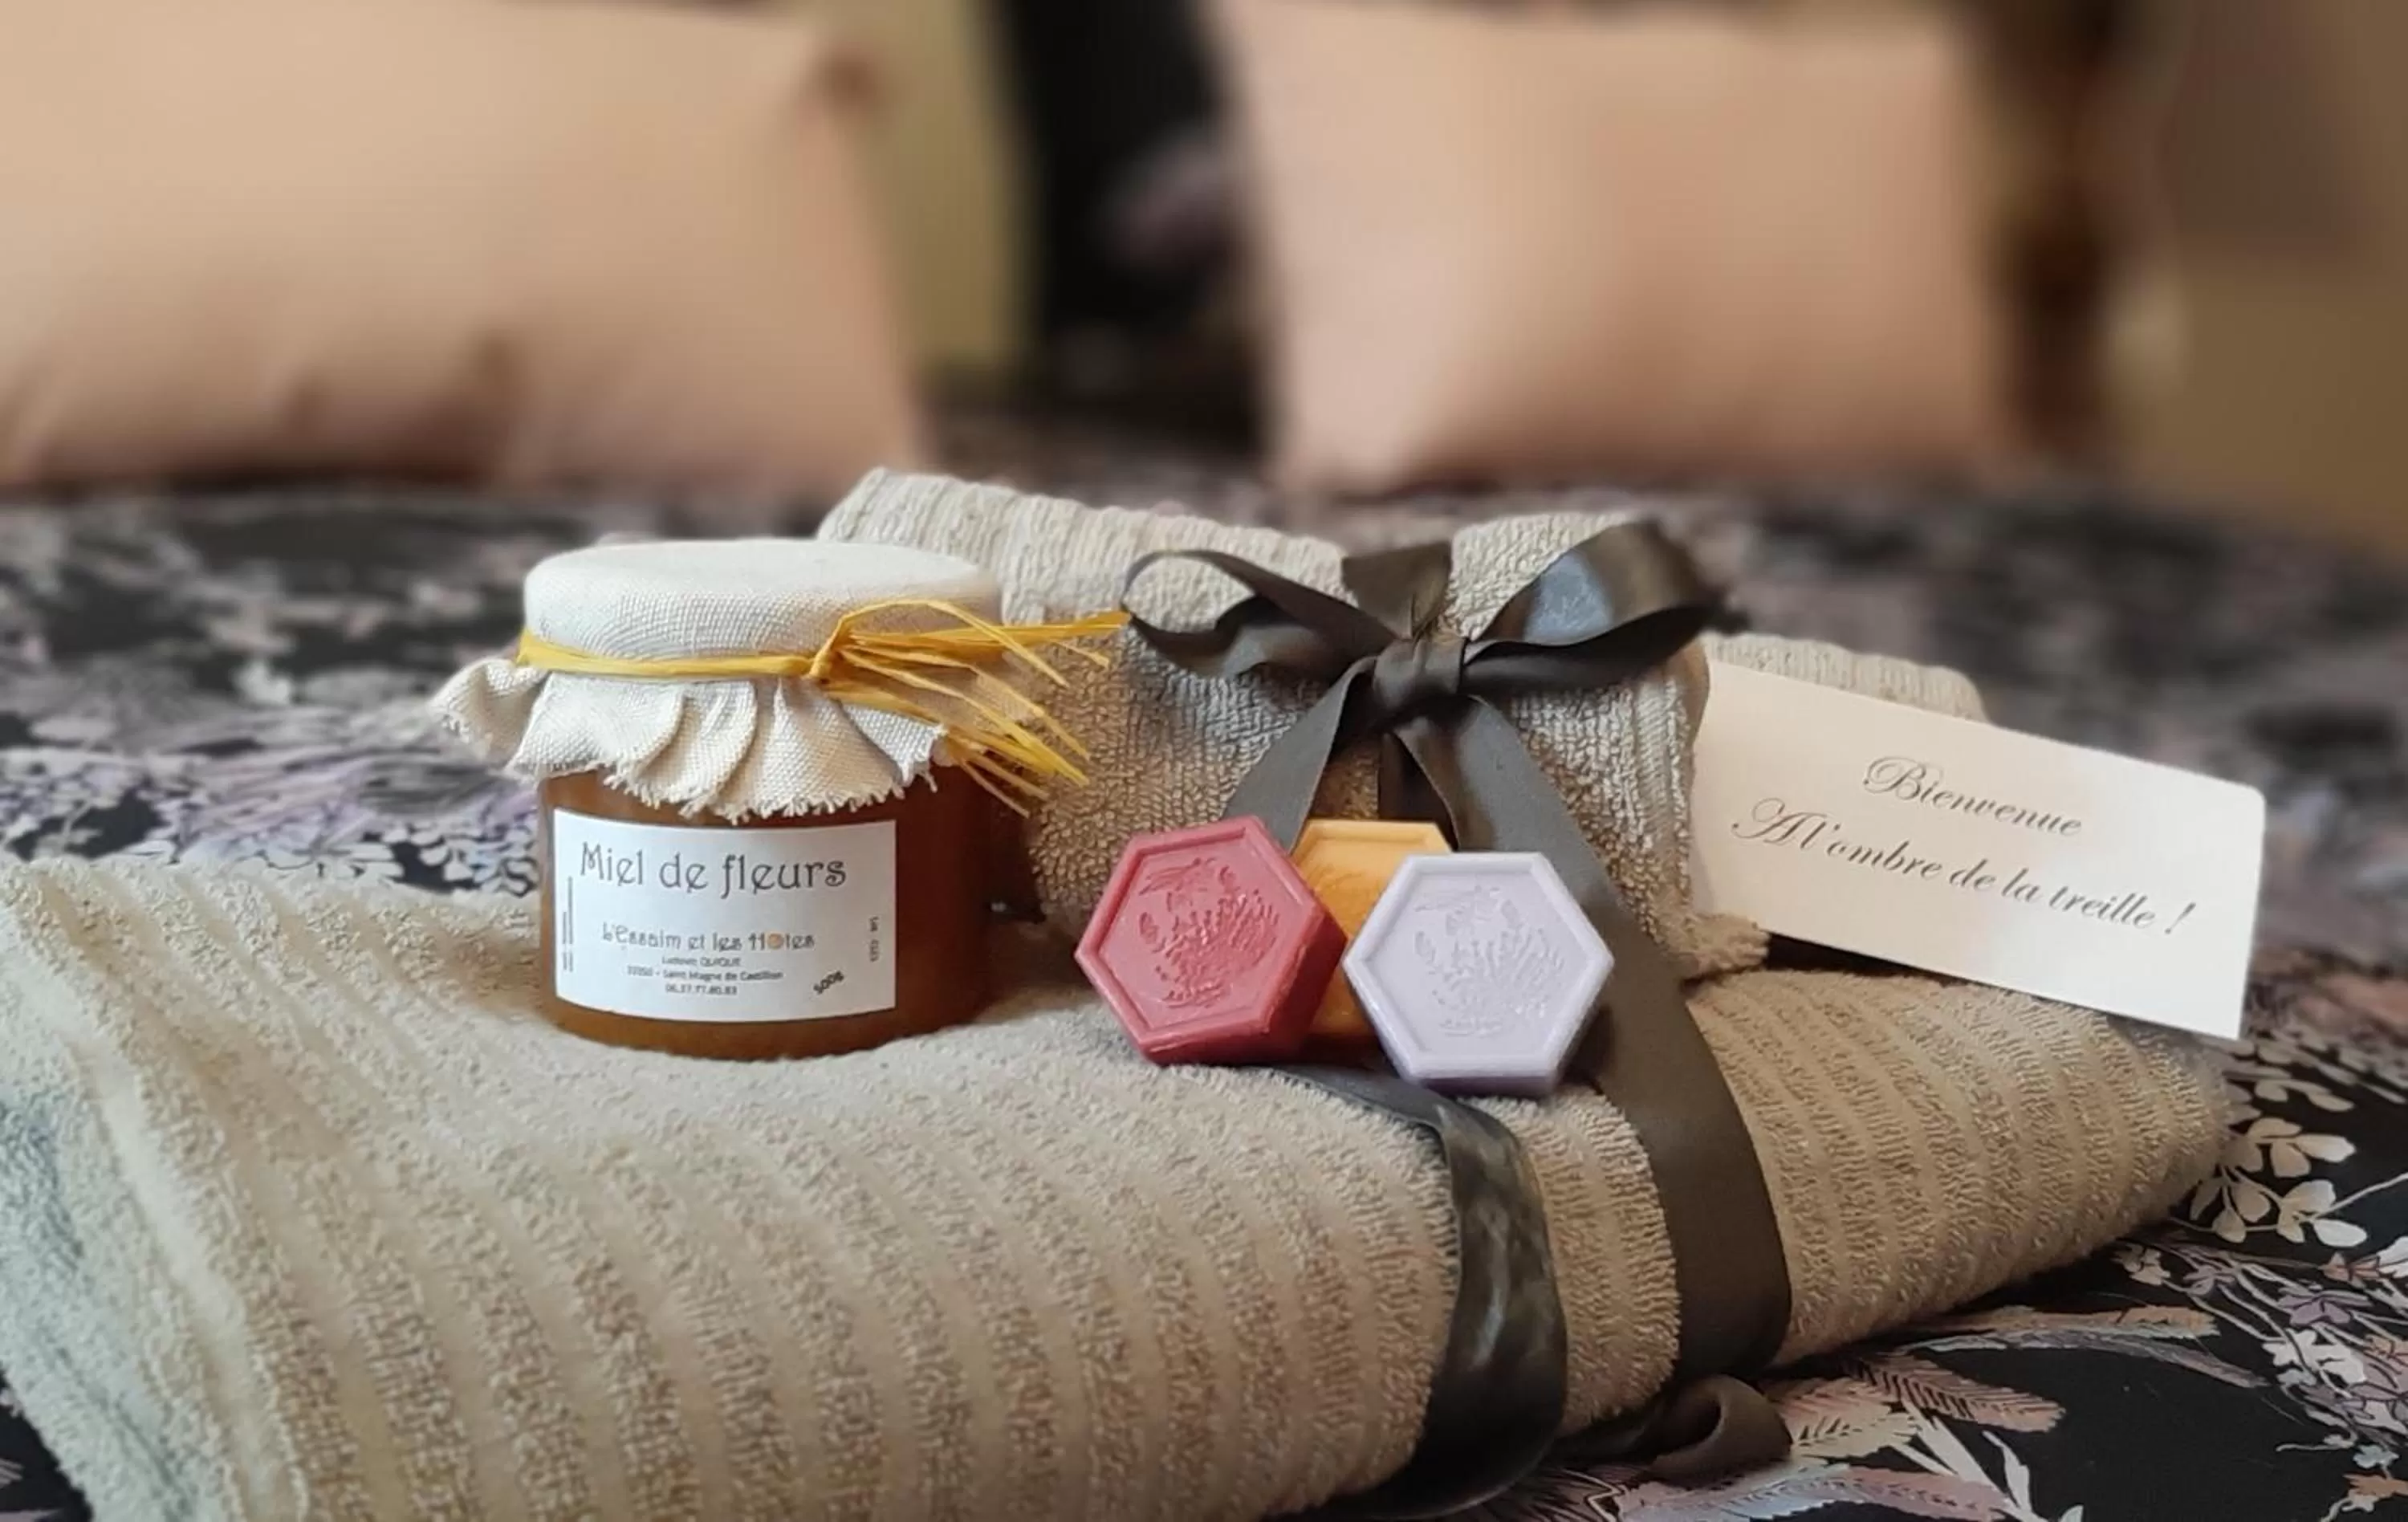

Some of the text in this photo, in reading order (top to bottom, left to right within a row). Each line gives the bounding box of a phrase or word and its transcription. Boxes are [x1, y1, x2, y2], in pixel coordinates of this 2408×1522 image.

[1862, 755, 2082, 836] Bienvenue
[580, 841, 848, 901] Miel de fleurs
[1950, 857, 1997, 890] de
[2001, 867, 2041, 902] la
[2048, 885, 2156, 929] treille
[688, 933, 706, 950] et
[712, 931, 743, 953] les
